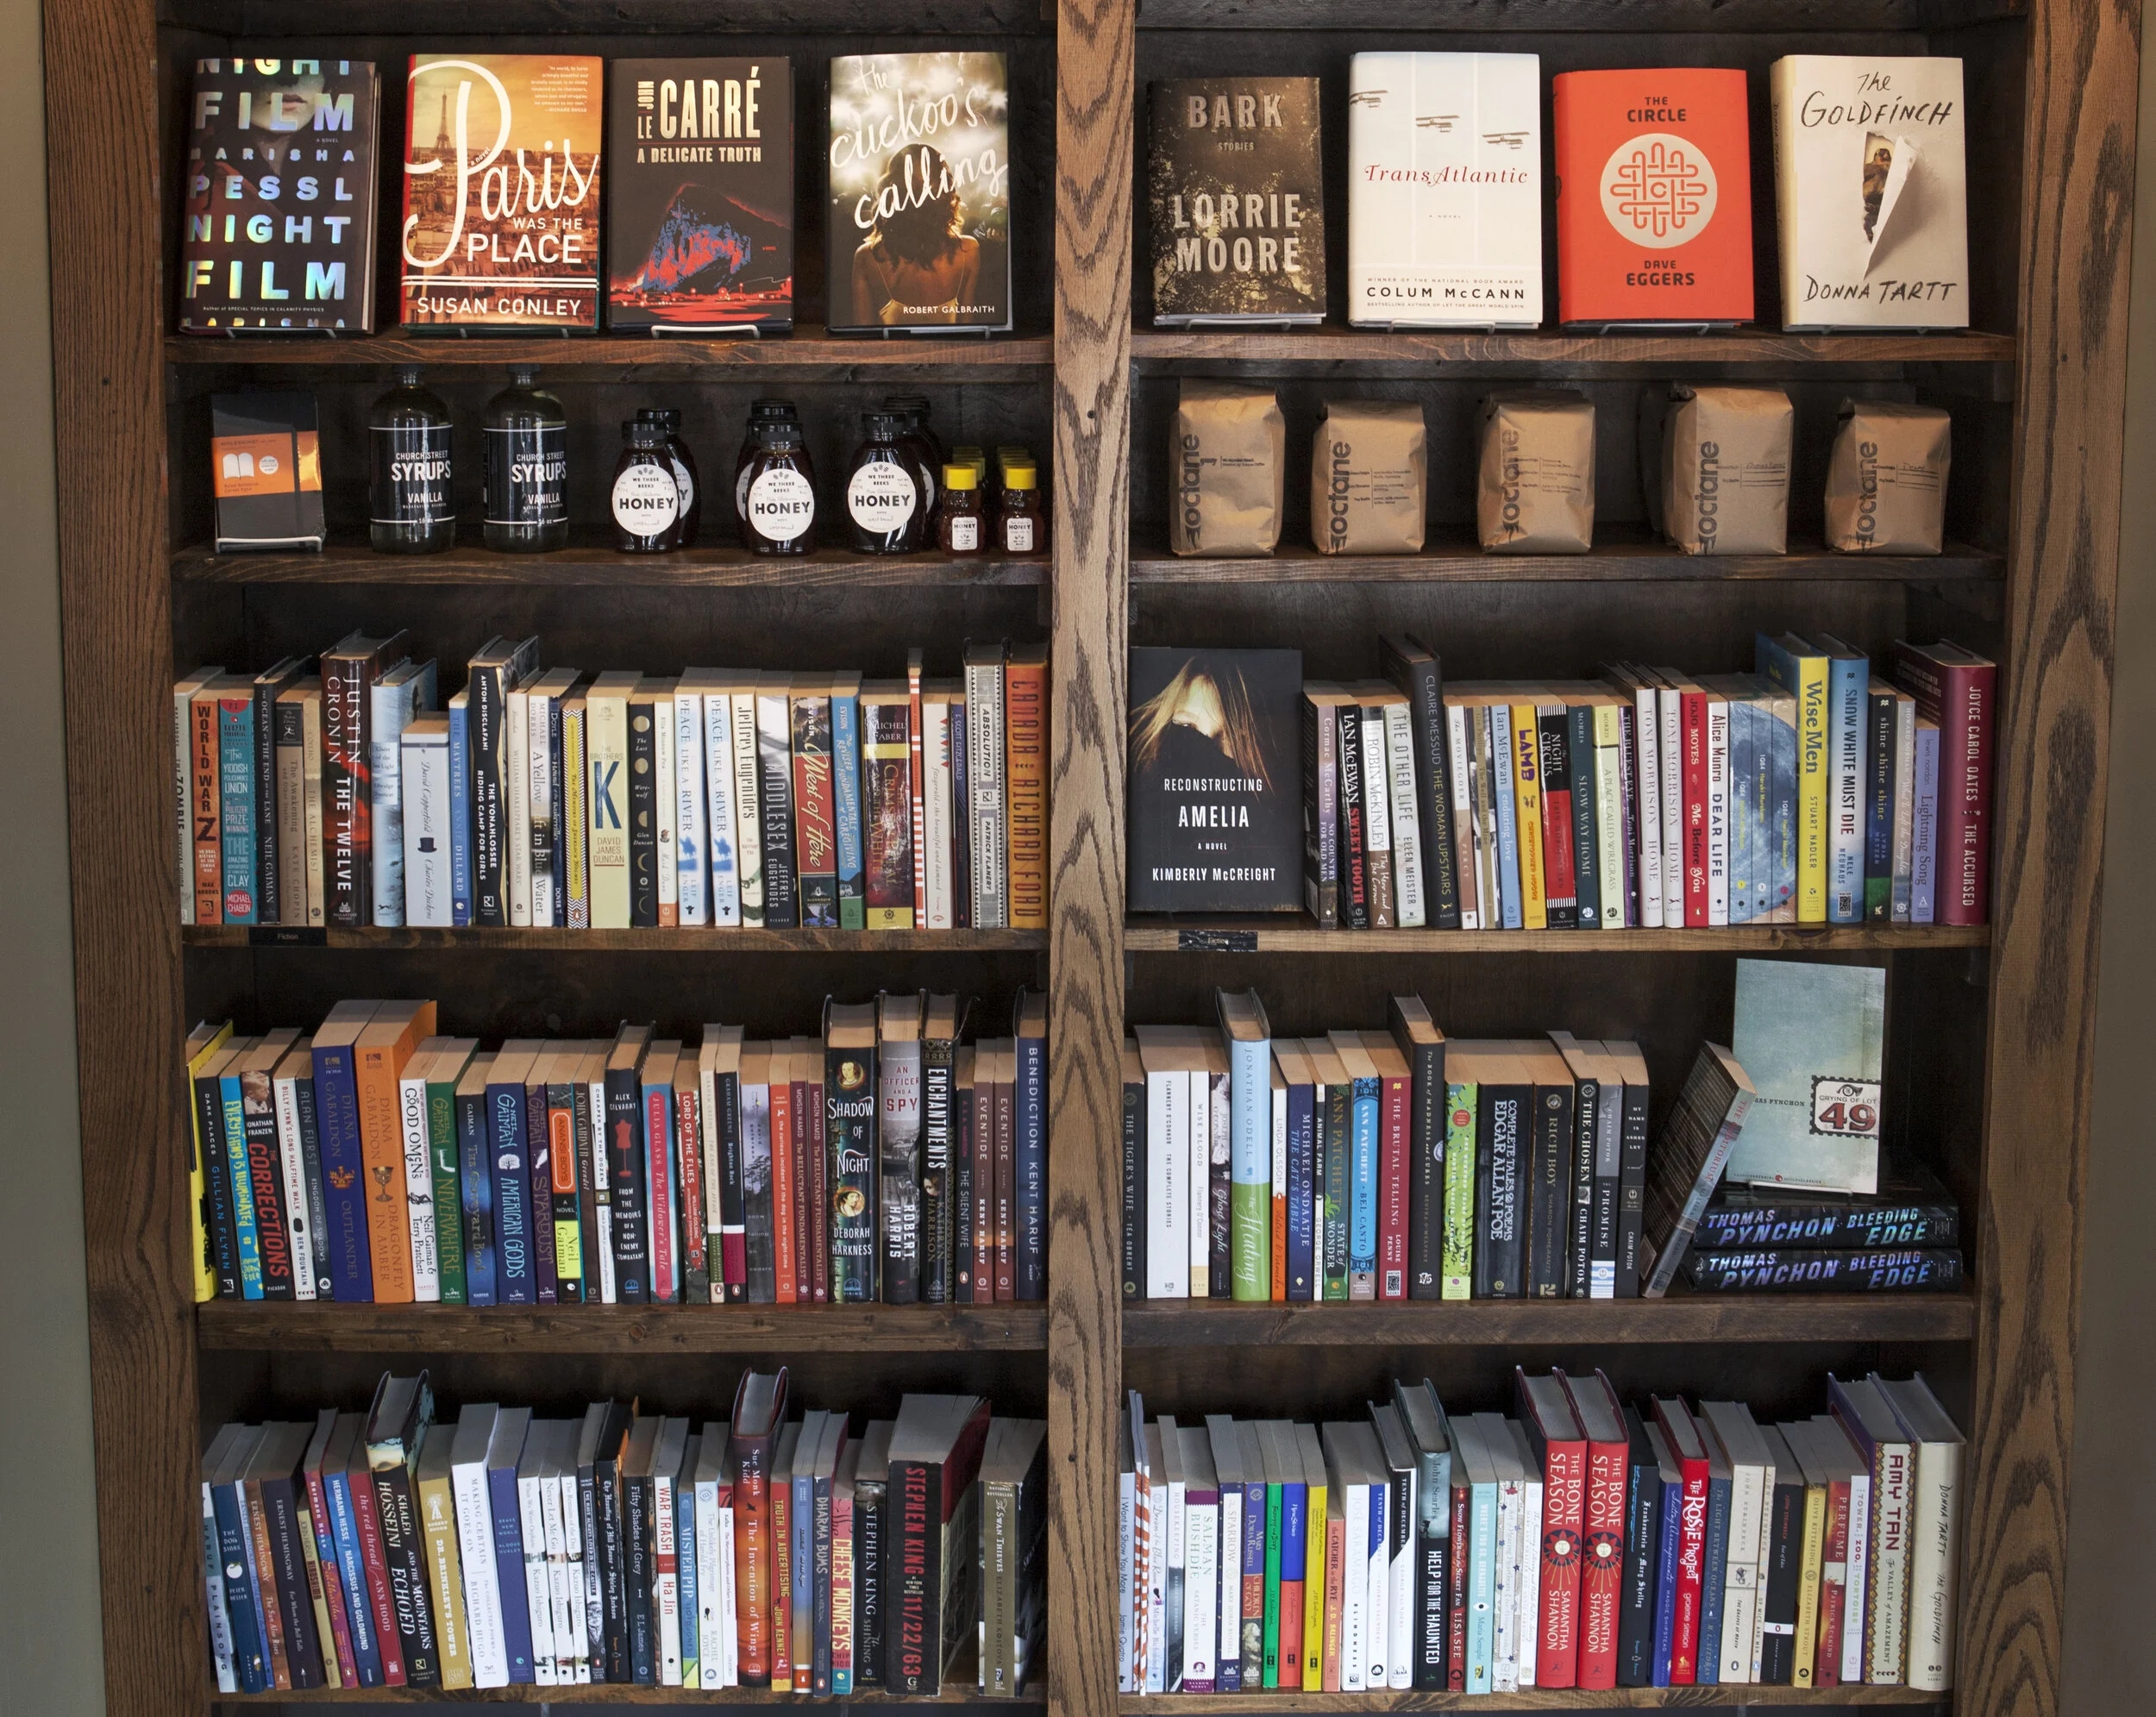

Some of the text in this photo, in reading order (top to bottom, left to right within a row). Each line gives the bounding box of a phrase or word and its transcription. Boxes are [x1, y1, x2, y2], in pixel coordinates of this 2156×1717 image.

[637, 81, 654, 110] JOHN
[1858, 72, 1891, 93] The
[196, 92, 354, 131] FILM
[638, 66, 761, 139] LE CARRÉ
[1188, 95, 1284, 128] BARK
[1627, 109, 1686, 122] CIRCLE
[830, 78, 979, 167] cuckoo's
[191, 149, 354, 161] MARISHA
[402, 60, 599, 267] Paris
[637, 147, 761, 163] A DELICATE TRUTH
[1218, 142, 1255, 151] STORIES
[190, 176, 352, 201] PESSL
[855, 147, 1009, 229] calling
[1364, 165, 1528, 186] TransAtlantic
[188, 216, 351, 243] NIGHT
[513, 217, 582, 230] WAS THE
[1174, 194, 1300, 229] LORRIE
[467, 235, 582, 264] PLACE
[1176, 238, 1300, 272] MOORE
[1645, 260, 1677, 269] DAVE
[185, 260, 345, 299] FILM
[1367, 287, 1524, 299] COLUM McCANN
[1626, 273, 1695, 285] EGGERS
[1806, 275, 1957, 304] DONNA TARTT
[417, 298, 580, 316] SUSAN CONLEY
[903, 306, 938, 315] ROBERT
[392, 461, 451, 480] SYRUPS
[427, 450, 448, 459] STREET
[407, 492, 442, 503] VANILLA
[1182, 434, 1200, 527] octane
[1332, 440, 1351, 535] octane
[1698, 441, 1719, 534] octane
[619, 498, 674, 511] HONEY
[755, 501, 811, 515] HONEY
[855, 495, 910, 507] HONEY
[343, 676, 360, 763] JUSTIN
[1806, 680, 1822, 774] Wise Men
[736, 707, 755, 818] Jeffrey Eugenides
[982, 709, 991, 777] ABSOLUTION
[1520, 730, 1535, 781] LAMB
[1840, 690, 1858, 835] SNOW WHITE MUST DIE
[196, 706, 216, 842] WORLD WAR Z
[327, 676, 351, 891] CRONIN THE TWELVE
[1165, 778, 1263, 792] RECONSTRUCTING
[594, 761, 622, 829] K
[765, 763, 787, 850] MIDDLESEX
[1012, 681, 1041, 917] CANADA RICHARD FORD
[1344, 714, 1364, 904] IAN McEWAN SWEET TOOTH
[1963, 686, 1981, 906] JOYCE CAROL OATES THE ACCURSED
[1179, 805, 1249, 827] AMELIA
[1712, 794, 1722, 877] DEAR LIFE
[1153, 868, 1275, 880] KIMBERLY McCREIGHT
[828, 1096, 874, 1119] SHADOW
[887, 1098, 917, 1112] SPY
[1029, 1048, 1037, 1149] BENEDICTION
[1819, 1102, 1877, 1131] 49
[853, 1126, 862, 1139] OF
[928, 1068, 947, 1169] ENCHANTMENTS
[837, 1150, 869, 1178] NIGHT
[1490, 1100, 1507, 1240] EDGAR ALLAN POE
[249, 1144, 290, 1277] CORRECTIONS
[1576, 1101, 1592, 1284] THE CHOSEN CHAIM POTOK
[501, 1178, 524, 1278] AMERICAN GODS
[834, 1228, 870, 1238] DEBORAH
[1029, 1206, 1038, 1254] HARUF
[1708, 1211, 1775, 1228] THOMAS
[1720, 1217, 1837, 1245] PYNCHON
[1846, 1208, 1918, 1229] BLEEDING
[1865, 1225, 1927, 1245] EDGE
[832, 1244, 872, 1256] HARKNESS
[1548, 1453, 1565, 1526] SEASON
[1565, 1453, 1582, 1525] THE BONE
[1885, 1455, 1903, 1551] AMY TAN
[378, 1482, 401, 1548] HOSSEINI
[397, 1495, 411, 1536] KHALED
[905, 1469, 926, 1574] STEPHEN KING
[392, 1567, 415, 1635] ECHOED
[832, 1538, 852, 1651] CHEESE MONKEYS
[1426, 1551, 1442, 1664] HELP FOR THE HAUNTED
[903, 1596, 925, 1676] 11/22/63
[1546, 1590, 1560, 1651] SHANNON
[1558, 1590, 1571, 1651] SAMANTHA
